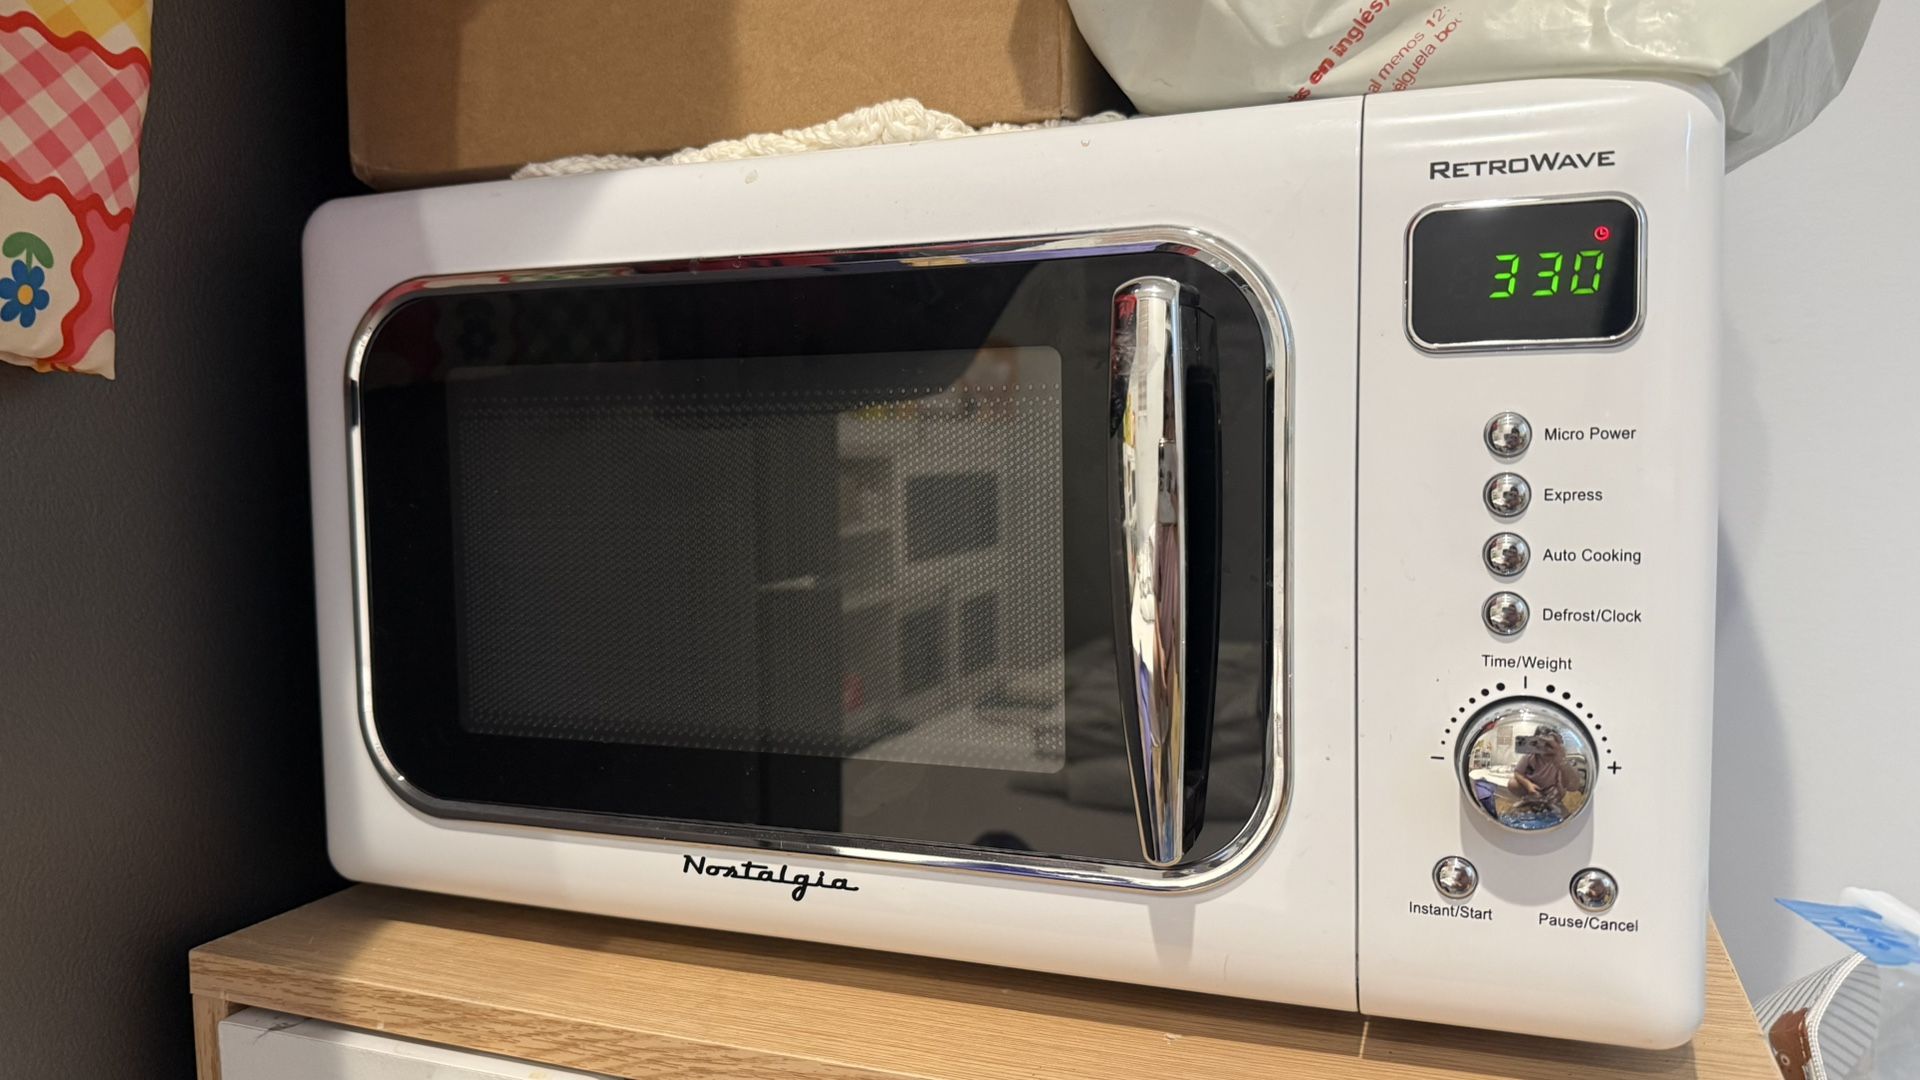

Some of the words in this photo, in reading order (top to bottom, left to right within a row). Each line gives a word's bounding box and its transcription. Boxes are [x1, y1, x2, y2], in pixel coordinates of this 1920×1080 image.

[1309, 58, 1335, 85] en
[1368, 78, 1382, 93] al
[1378, 32, 1425, 80] menos
[1544, 427, 1585, 441] Micro
[1589, 426, 1637, 440] Power
[1544, 488, 1603, 503] Express
[1543, 548, 1577, 562] Auto
[1581, 548, 1642, 566] Cooking
[1542, 607, 1642, 623] Defrost/Clock
[1481, 654, 1573, 673] Time/Weight
[683, 854, 860, 902] Nostalgia
[1409, 900, 1493, 921] Instant/Start
[1538, 912, 1639, 933] Pause/Cancel
